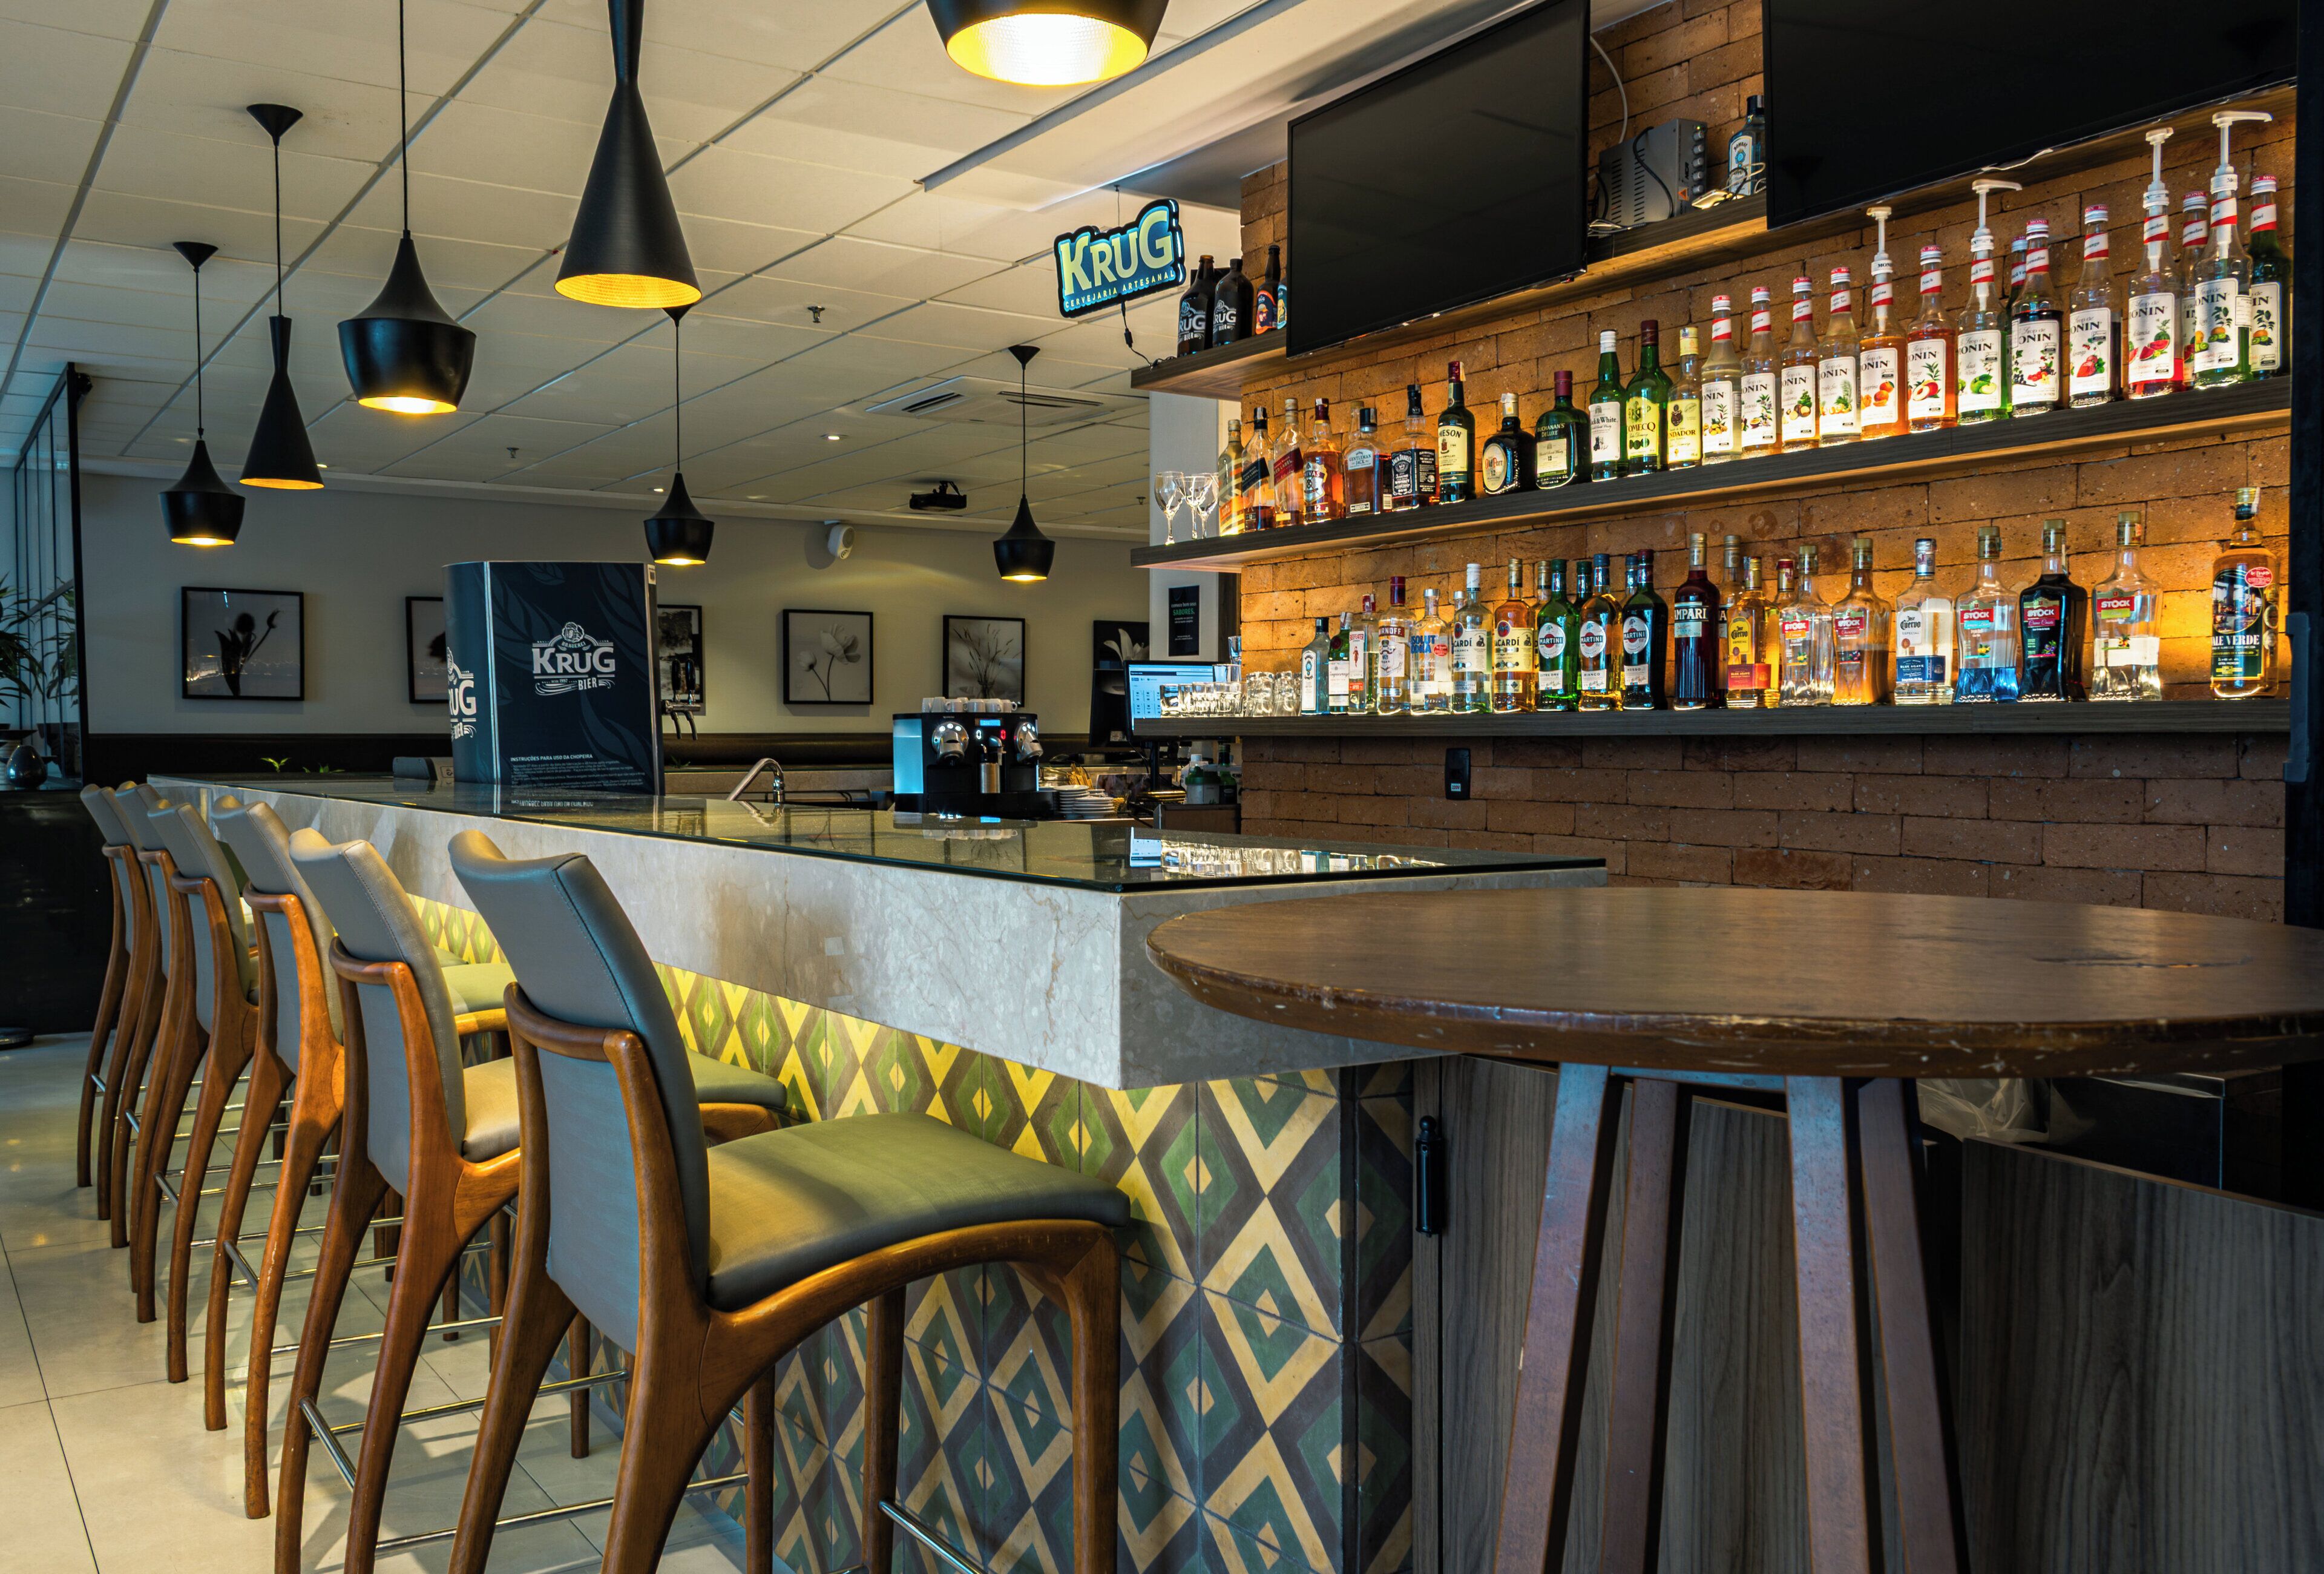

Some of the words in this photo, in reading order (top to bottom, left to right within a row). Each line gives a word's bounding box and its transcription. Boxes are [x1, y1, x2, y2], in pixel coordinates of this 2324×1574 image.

[1060, 210, 1173, 296] KRUG
[1065, 287, 1117, 308] CERVEJARIA
[1122, 270, 1174, 291] ARTESANAL
[2196, 292, 2227, 306] ONIN
[1213, 311, 1236, 324] RUG
[2129, 306, 2165, 320] ONIN
[1179, 315, 1206, 331] RUG
[2070, 321, 2100, 334] ONIN
[1184, 332, 1194, 341] BIER
[2018, 333, 2051, 344] ONIN
[1960, 343, 1992, 355] ONIN
[1908, 351, 1937, 362] ONIN
[1861, 360, 1889, 371] ONIN
[1819, 368, 1848, 380] ONIN
[1782, 377, 1807, 387] ONIN
[1741, 384, 1768, 394] ONIN
[1628, 422, 1656, 432] OMECQ
[1439, 429, 1462, 438] ESON
[2101, 599, 2130, 608] STOCK
[2027, 609, 2055, 617] STOCK
[1900, 620, 1921, 630] Cuervo
[1624, 631, 1646, 639] MARTINI
[2226, 634, 2260, 645] VERDE
[532, 647, 615, 674] KRUG
[578, 677, 598, 690] BIER
